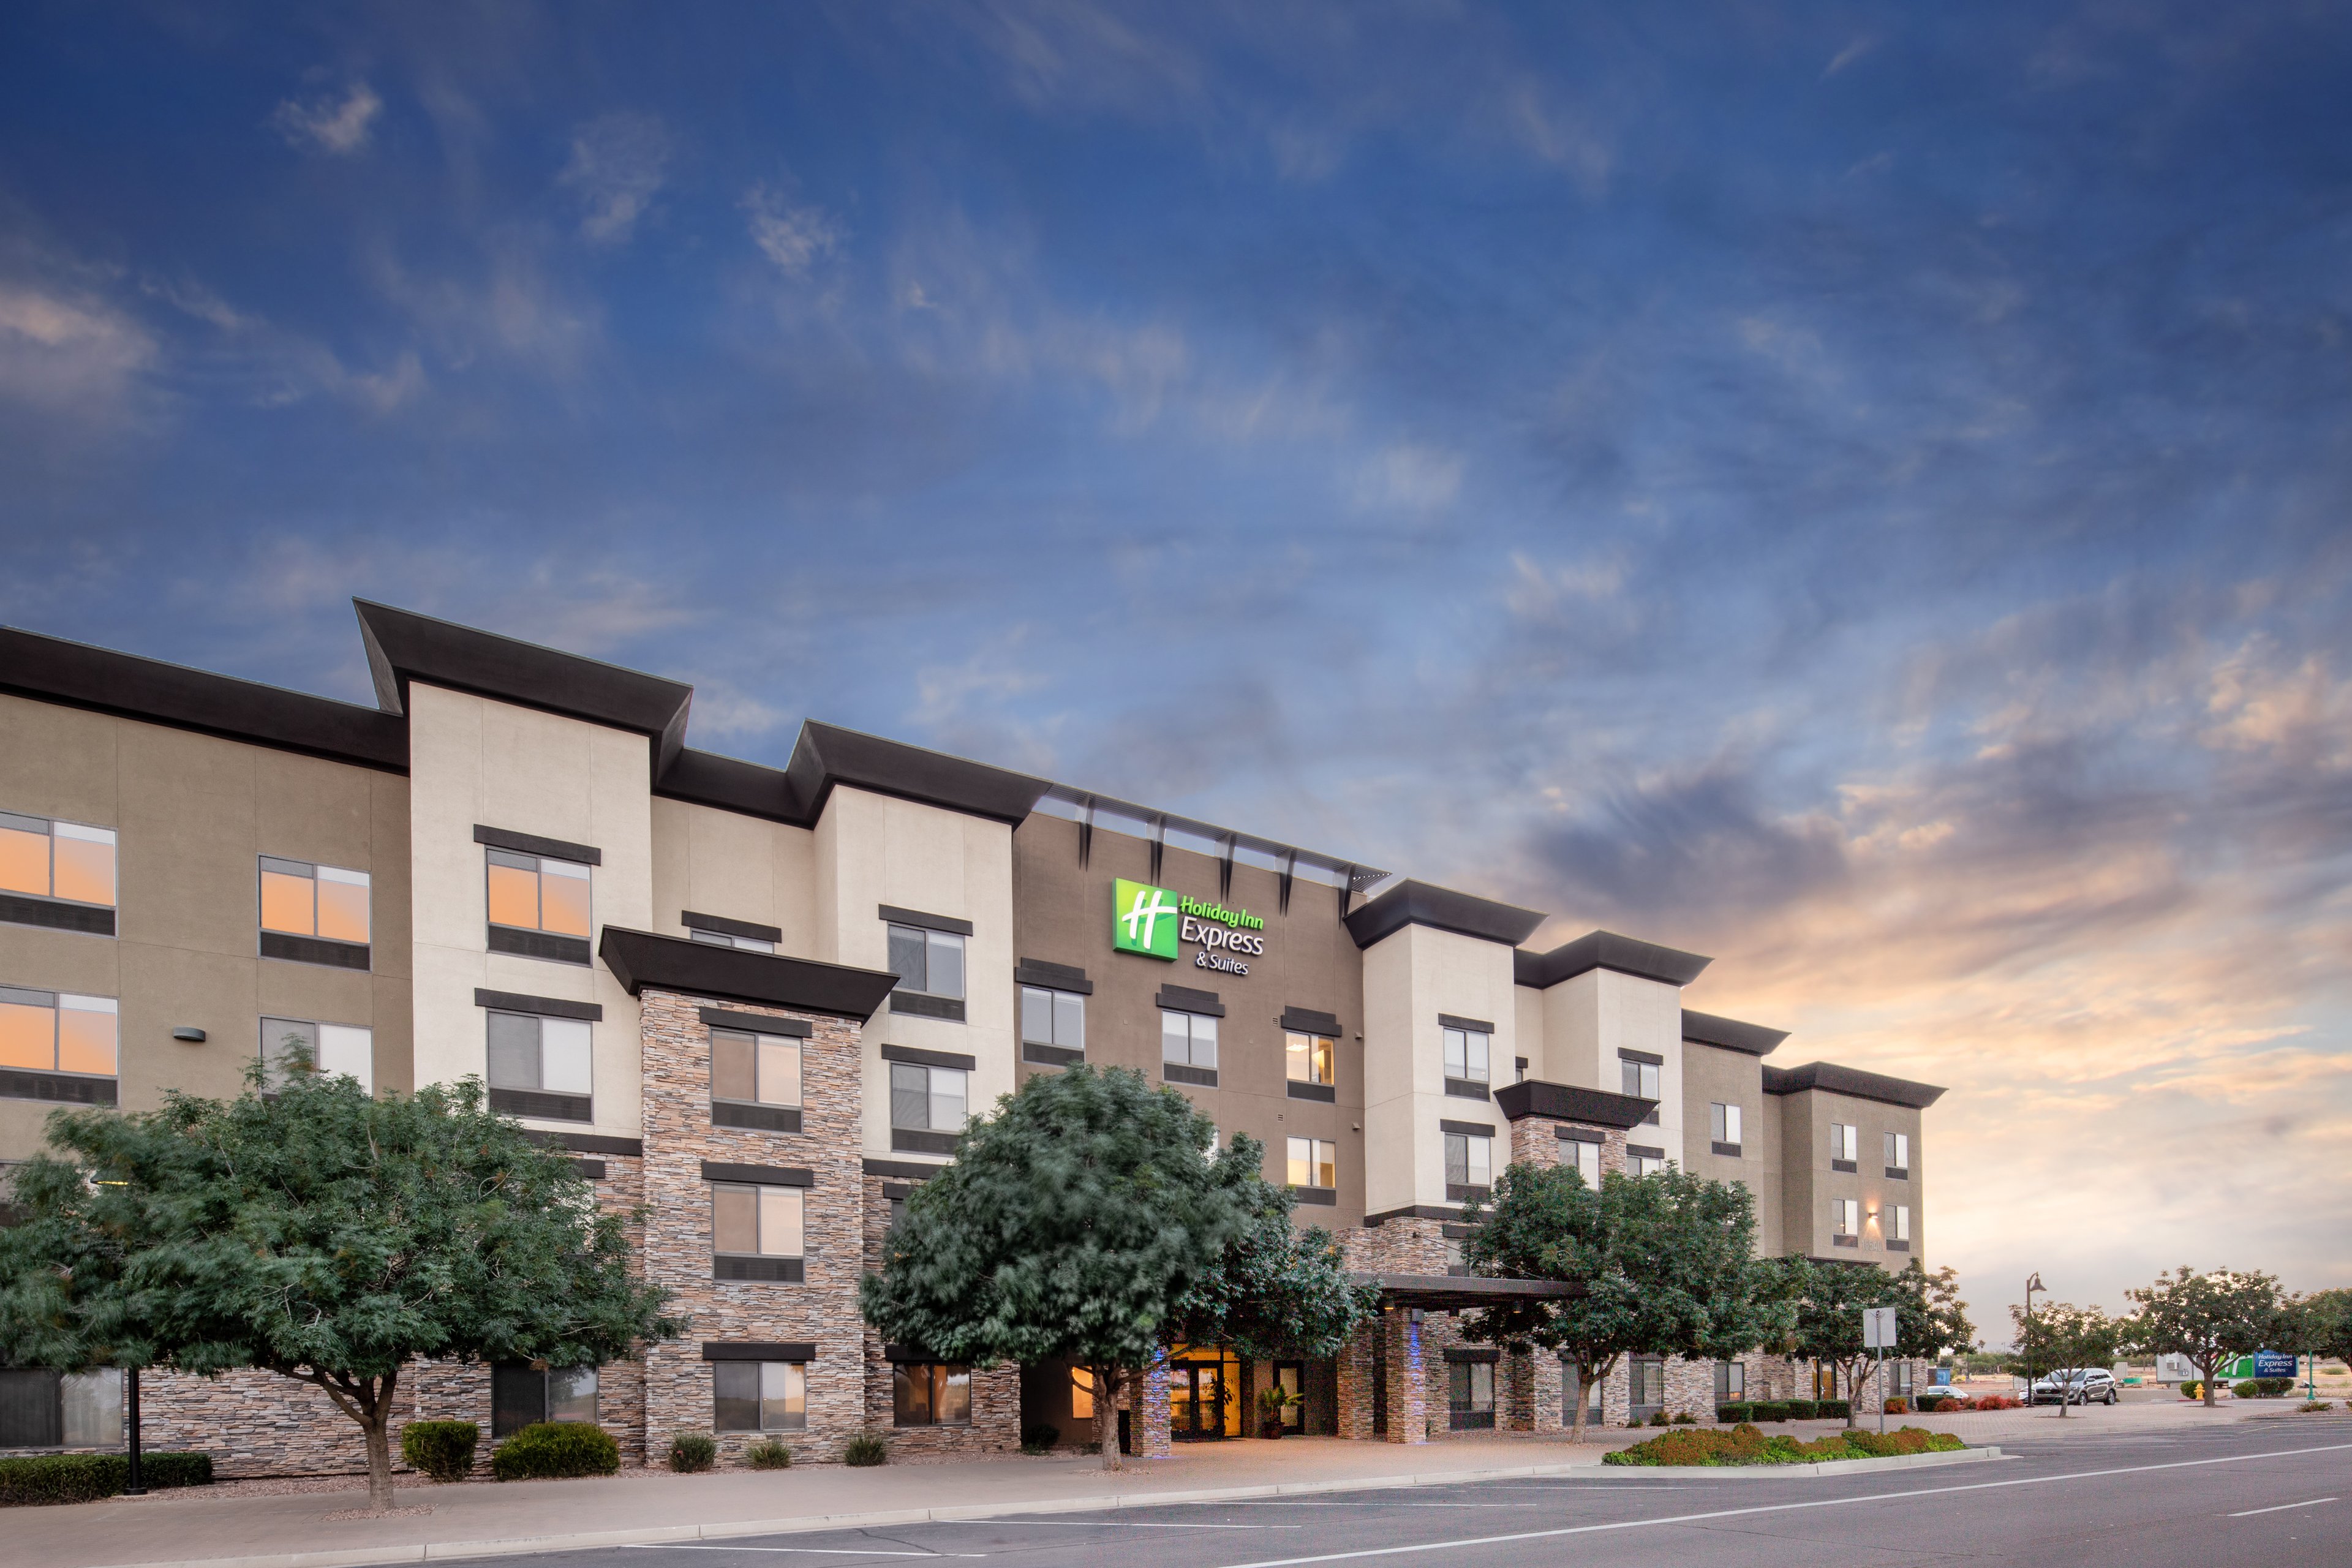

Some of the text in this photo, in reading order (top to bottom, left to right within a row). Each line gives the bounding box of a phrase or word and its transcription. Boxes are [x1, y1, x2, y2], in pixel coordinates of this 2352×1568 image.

[1180, 895, 1264, 930] Holiday Inn
[1181, 916, 1264, 956] Express
[1196, 951, 1248, 974] & Suites
